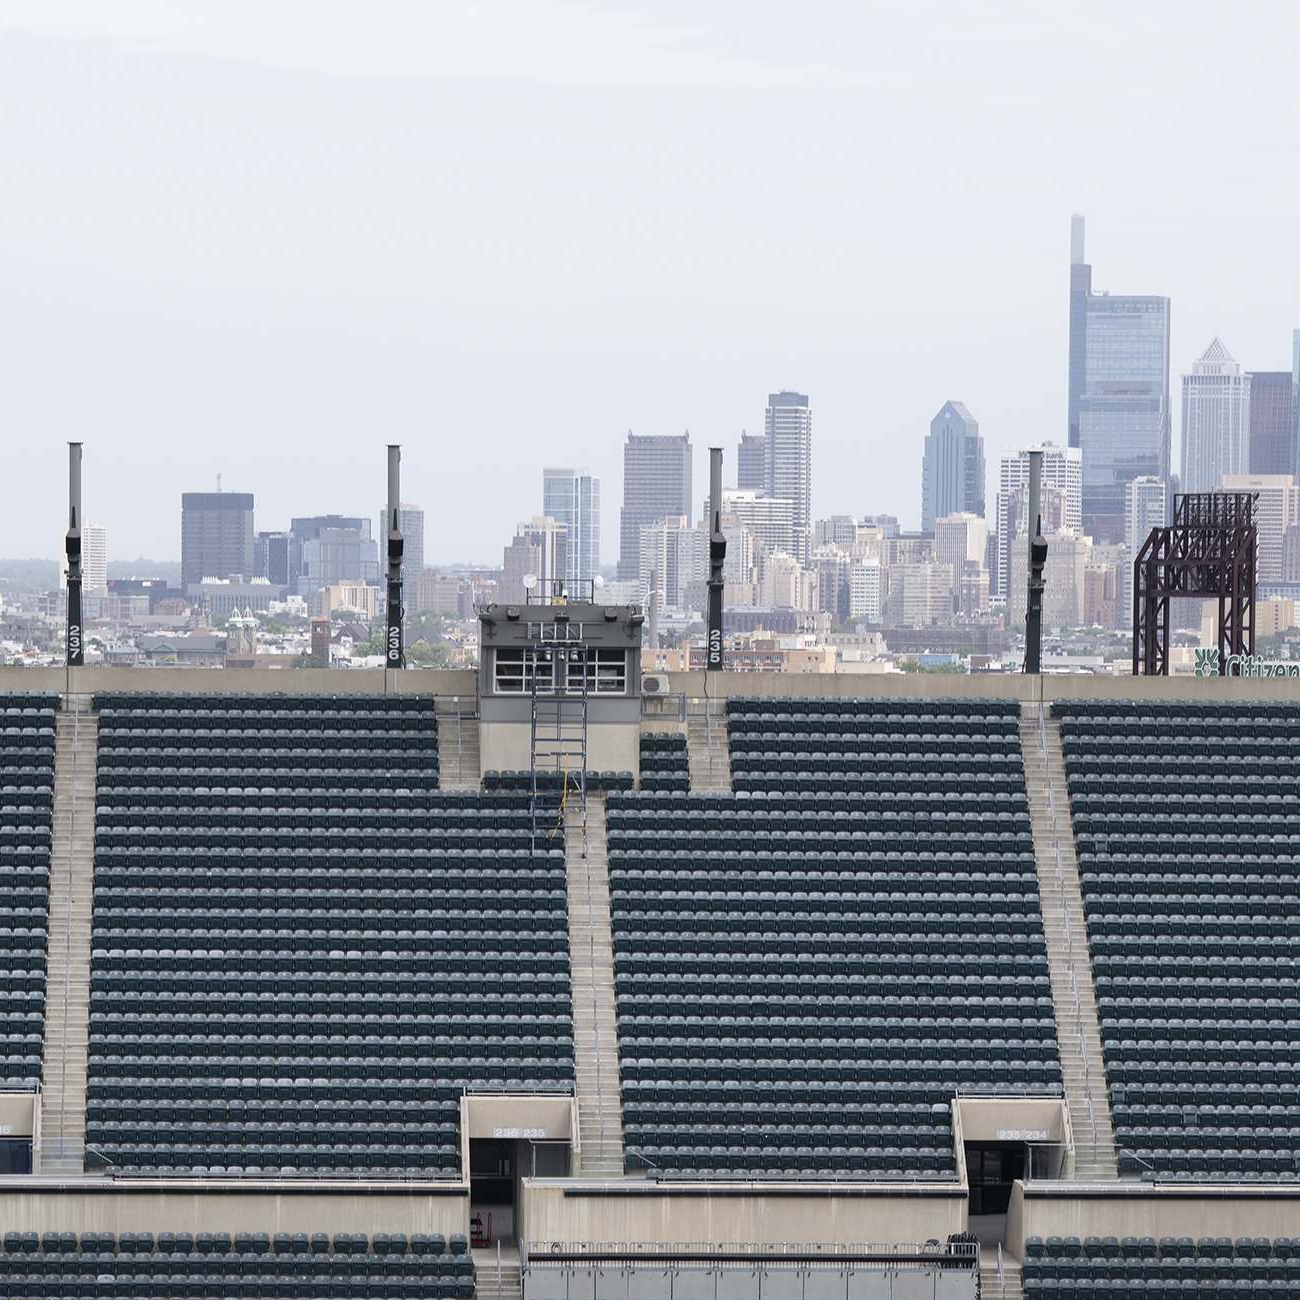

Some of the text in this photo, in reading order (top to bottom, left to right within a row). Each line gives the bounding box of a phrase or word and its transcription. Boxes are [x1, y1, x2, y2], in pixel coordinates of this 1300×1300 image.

[69, 625, 80, 659] 237
[389, 626, 400, 660] 236
[710, 629, 721, 664] 235
[495, 1128, 518, 1138] 236
[523, 1128, 545, 1138] 235
[999, 1130, 1021, 1139] 235
[1025, 1130, 1047, 1139] 234
